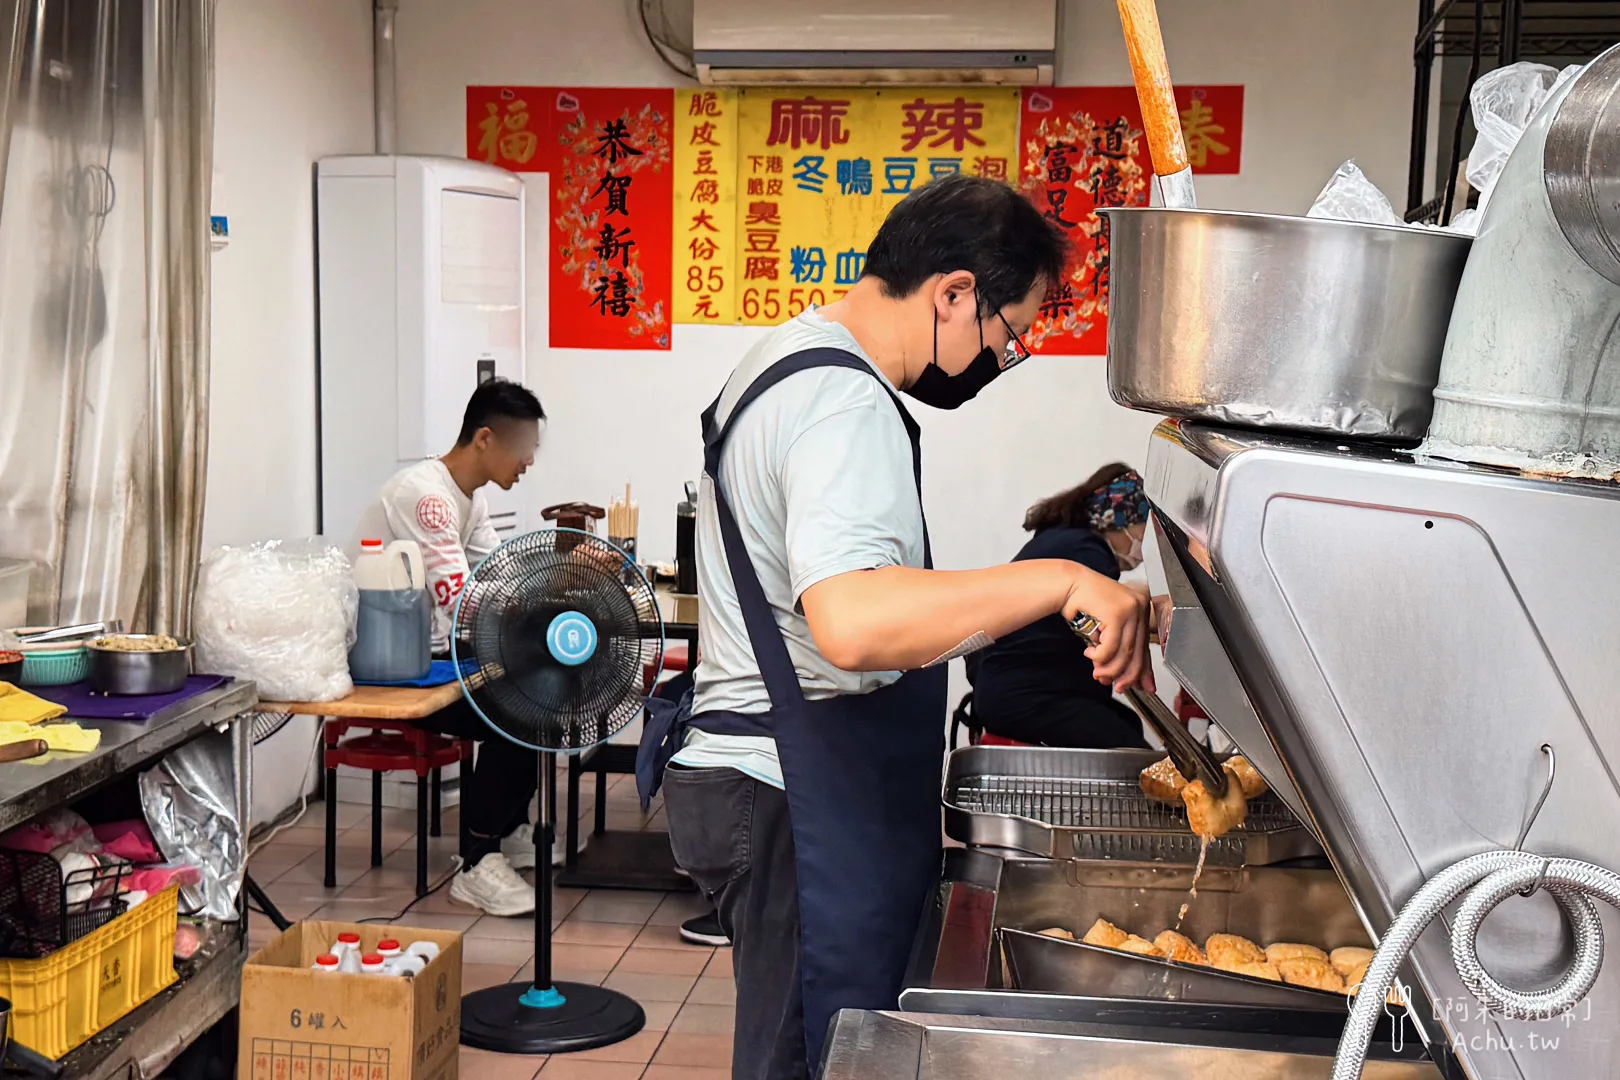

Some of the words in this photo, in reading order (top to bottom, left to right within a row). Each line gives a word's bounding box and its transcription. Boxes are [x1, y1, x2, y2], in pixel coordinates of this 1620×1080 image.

[478, 99, 537, 163] 福
[766, 96, 986, 151] 麻辣
[1178, 97, 1230, 167] 春
[590, 118, 643, 317] 恭賀新禧
[743, 288, 780, 319] 65
